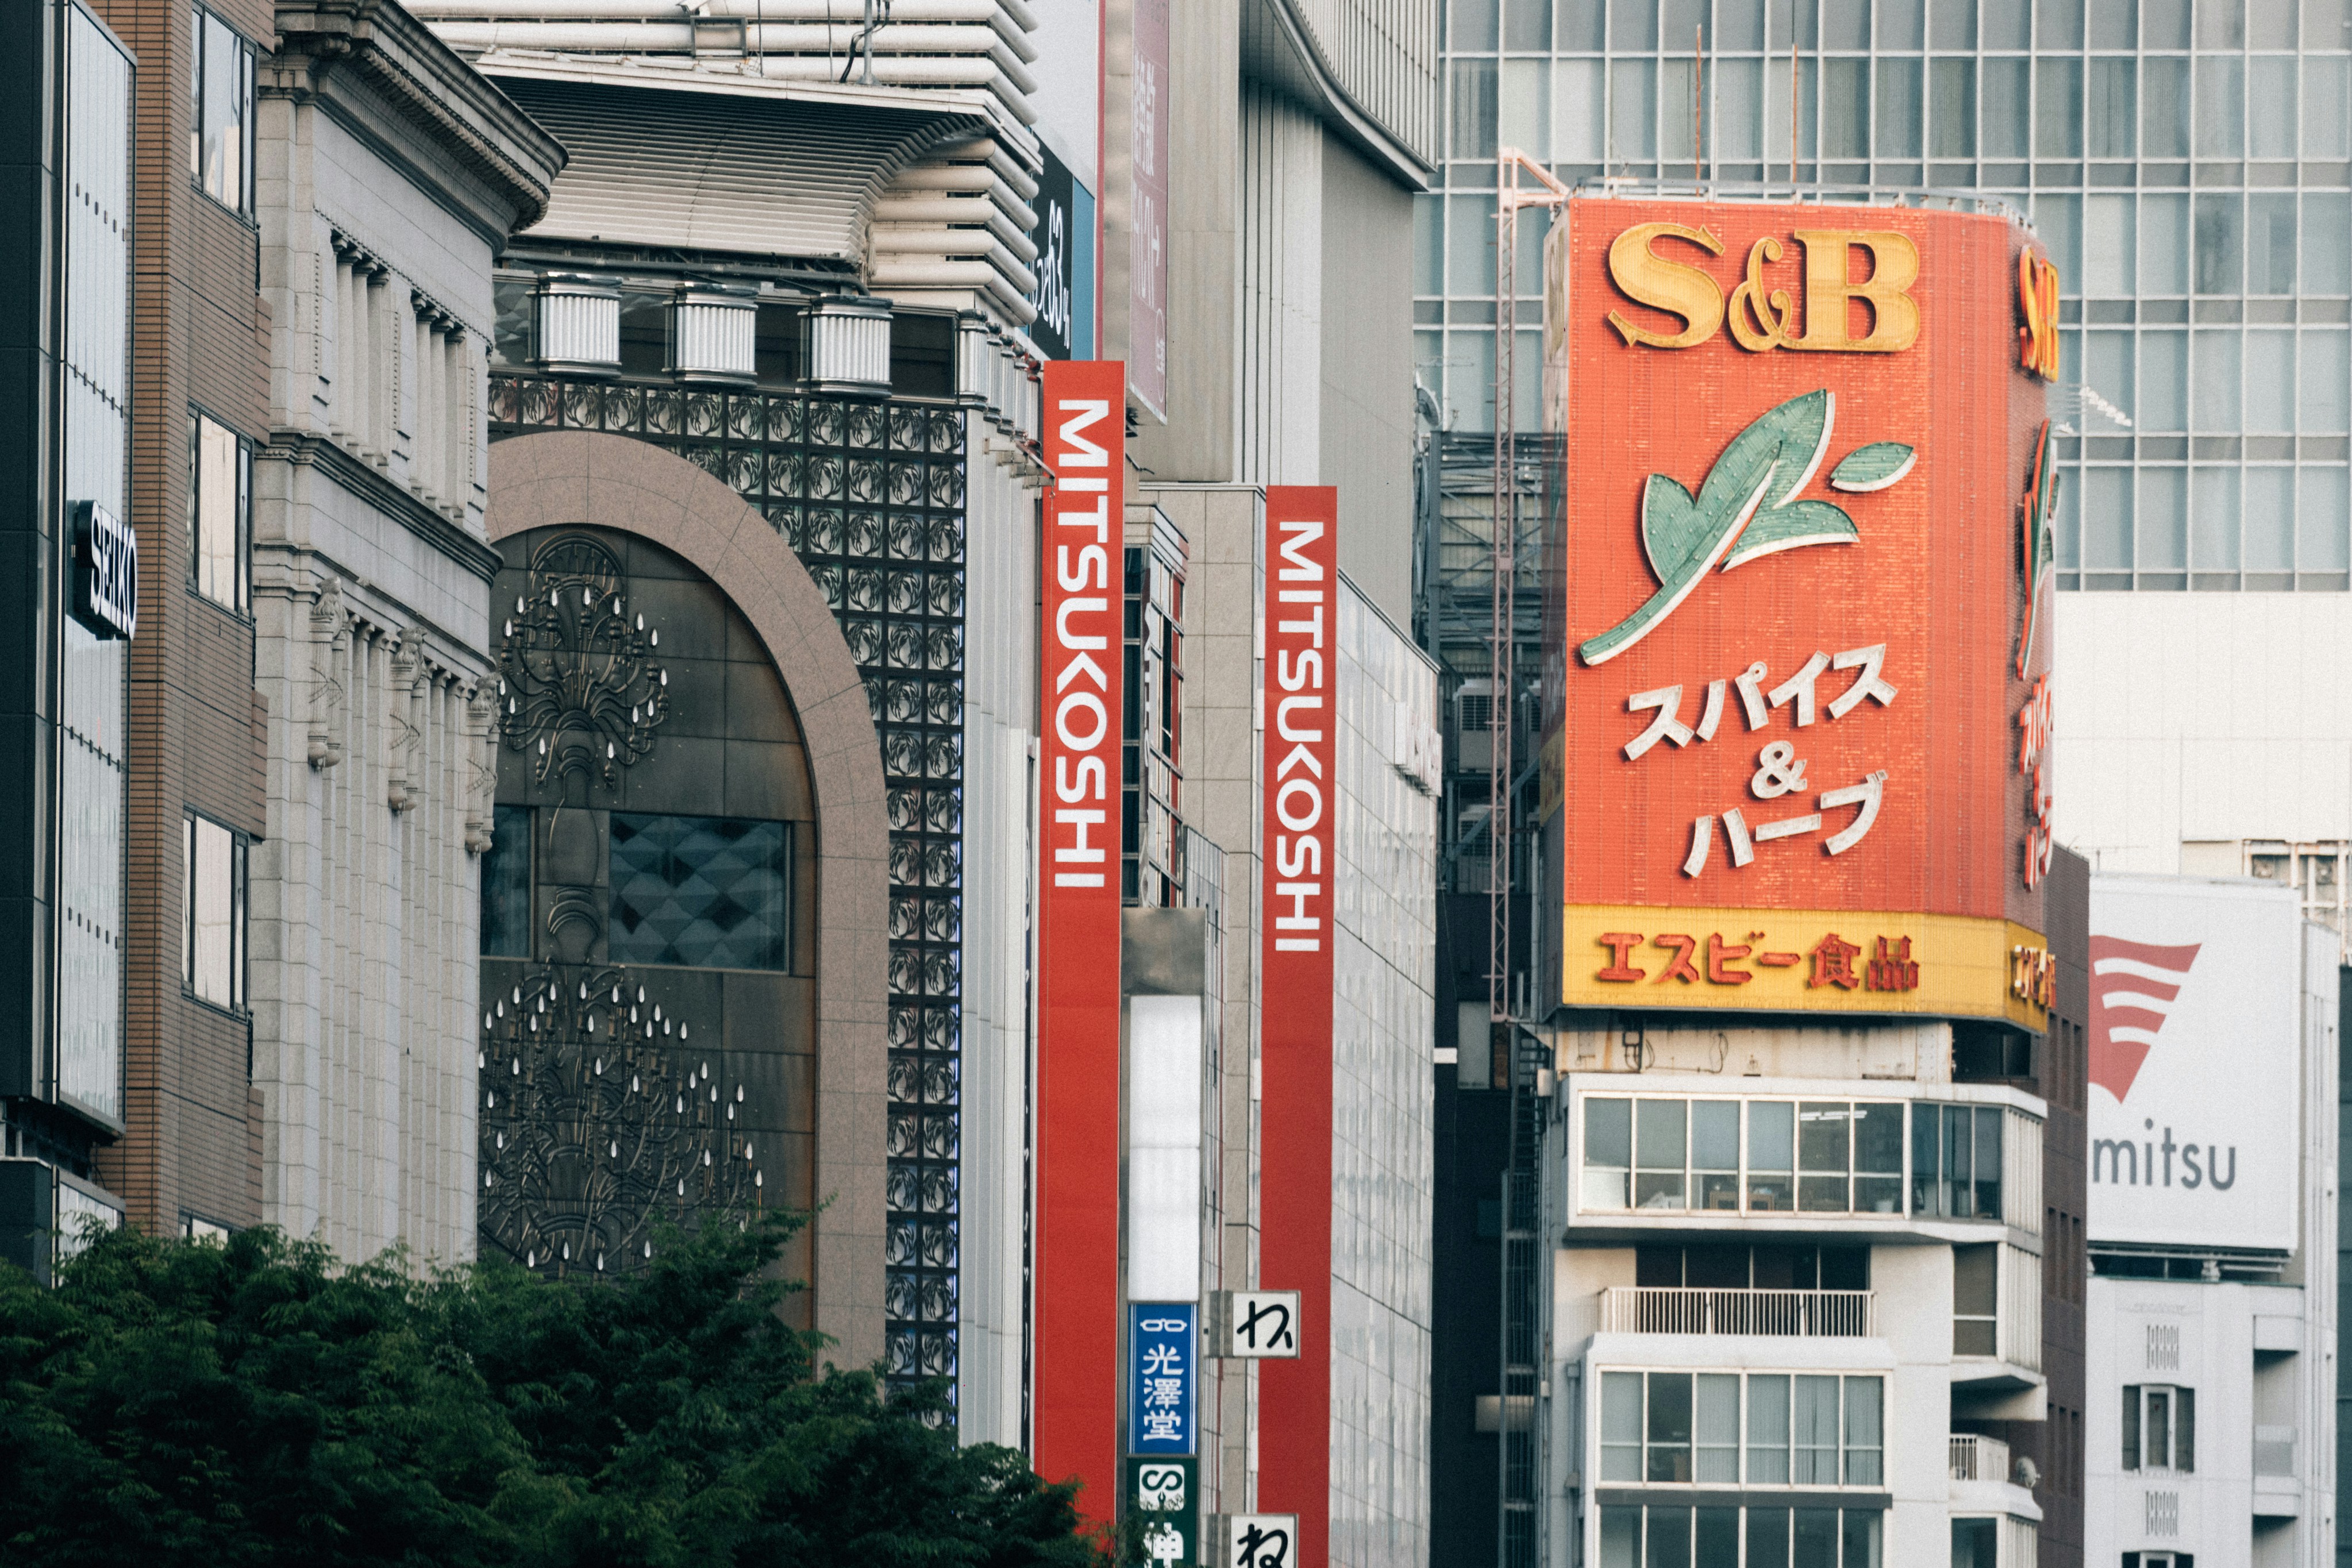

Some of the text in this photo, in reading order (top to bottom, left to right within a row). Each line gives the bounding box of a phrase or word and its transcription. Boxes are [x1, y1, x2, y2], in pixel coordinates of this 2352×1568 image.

[1608, 222, 1920, 352] S&B
[90, 500, 137, 641] SEIKO
[1054, 399, 1110, 888] MITSUKOSHI
[1275, 521, 1324, 952] MITSUKOSHI
[1624, 642, 1899, 761] スパイス
[1683, 769, 1889, 879] ハーブ
[1751, 740, 1808, 799] &
[1595, 931, 1920, 991] エスビー食品
[2092, 1118, 2236, 1191] mitsu
[1141, 1343, 1184, 1441] 光澤堂
